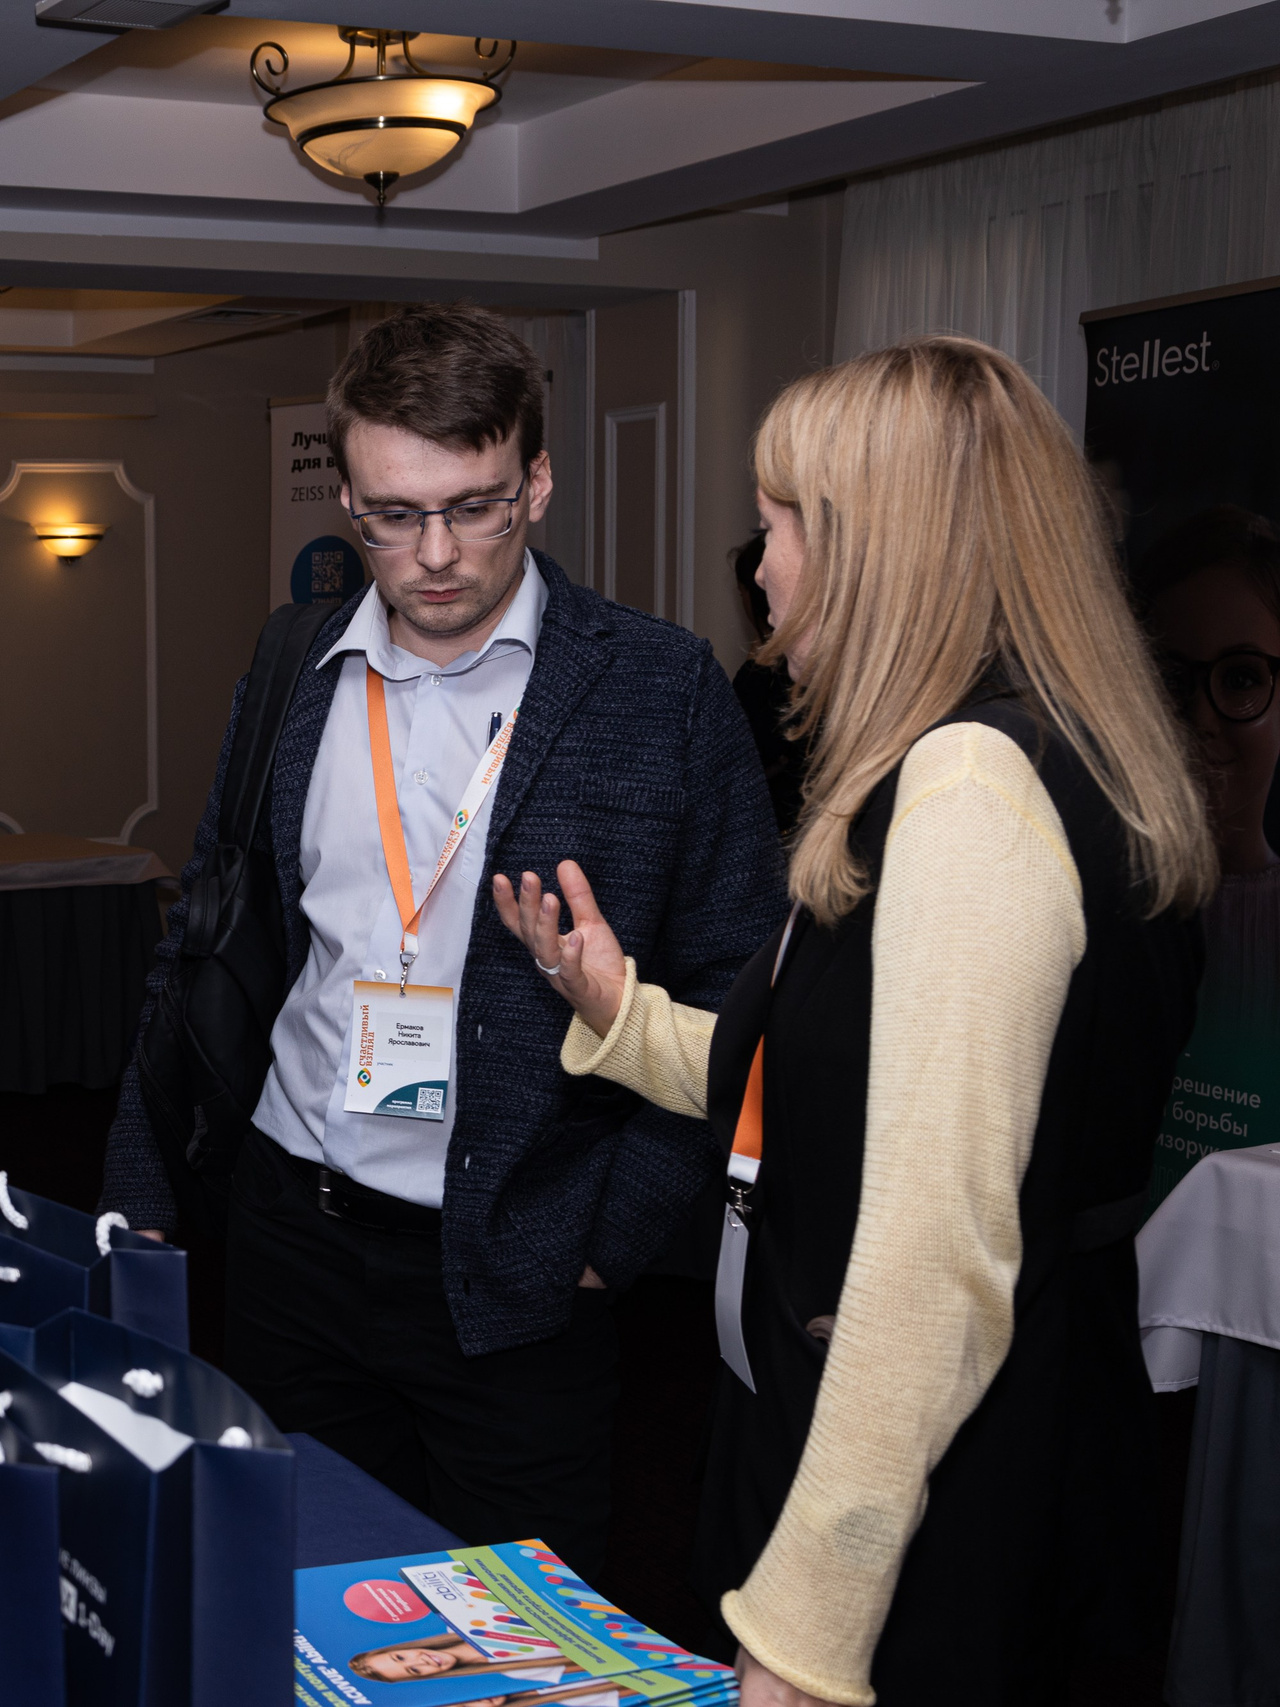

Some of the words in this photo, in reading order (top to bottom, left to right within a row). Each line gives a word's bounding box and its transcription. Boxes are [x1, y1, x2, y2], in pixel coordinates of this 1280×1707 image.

[291, 457, 321, 473] для
[291, 486, 325, 502] ZEISS
[489, 721, 514, 755] ВЗГЛЯД
[395, 1023, 424, 1031] Ермаков
[397, 1031, 422, 1039] Никита
[358, 1004, 370, 1067] СЧАСТЛИВЫЙ
[387, 1038, 431, 1048] Ярославович
[366, 1031, 375, 1067] ВЗГЛЯД
[1172, 1101, 1248, 1137] борьбы
